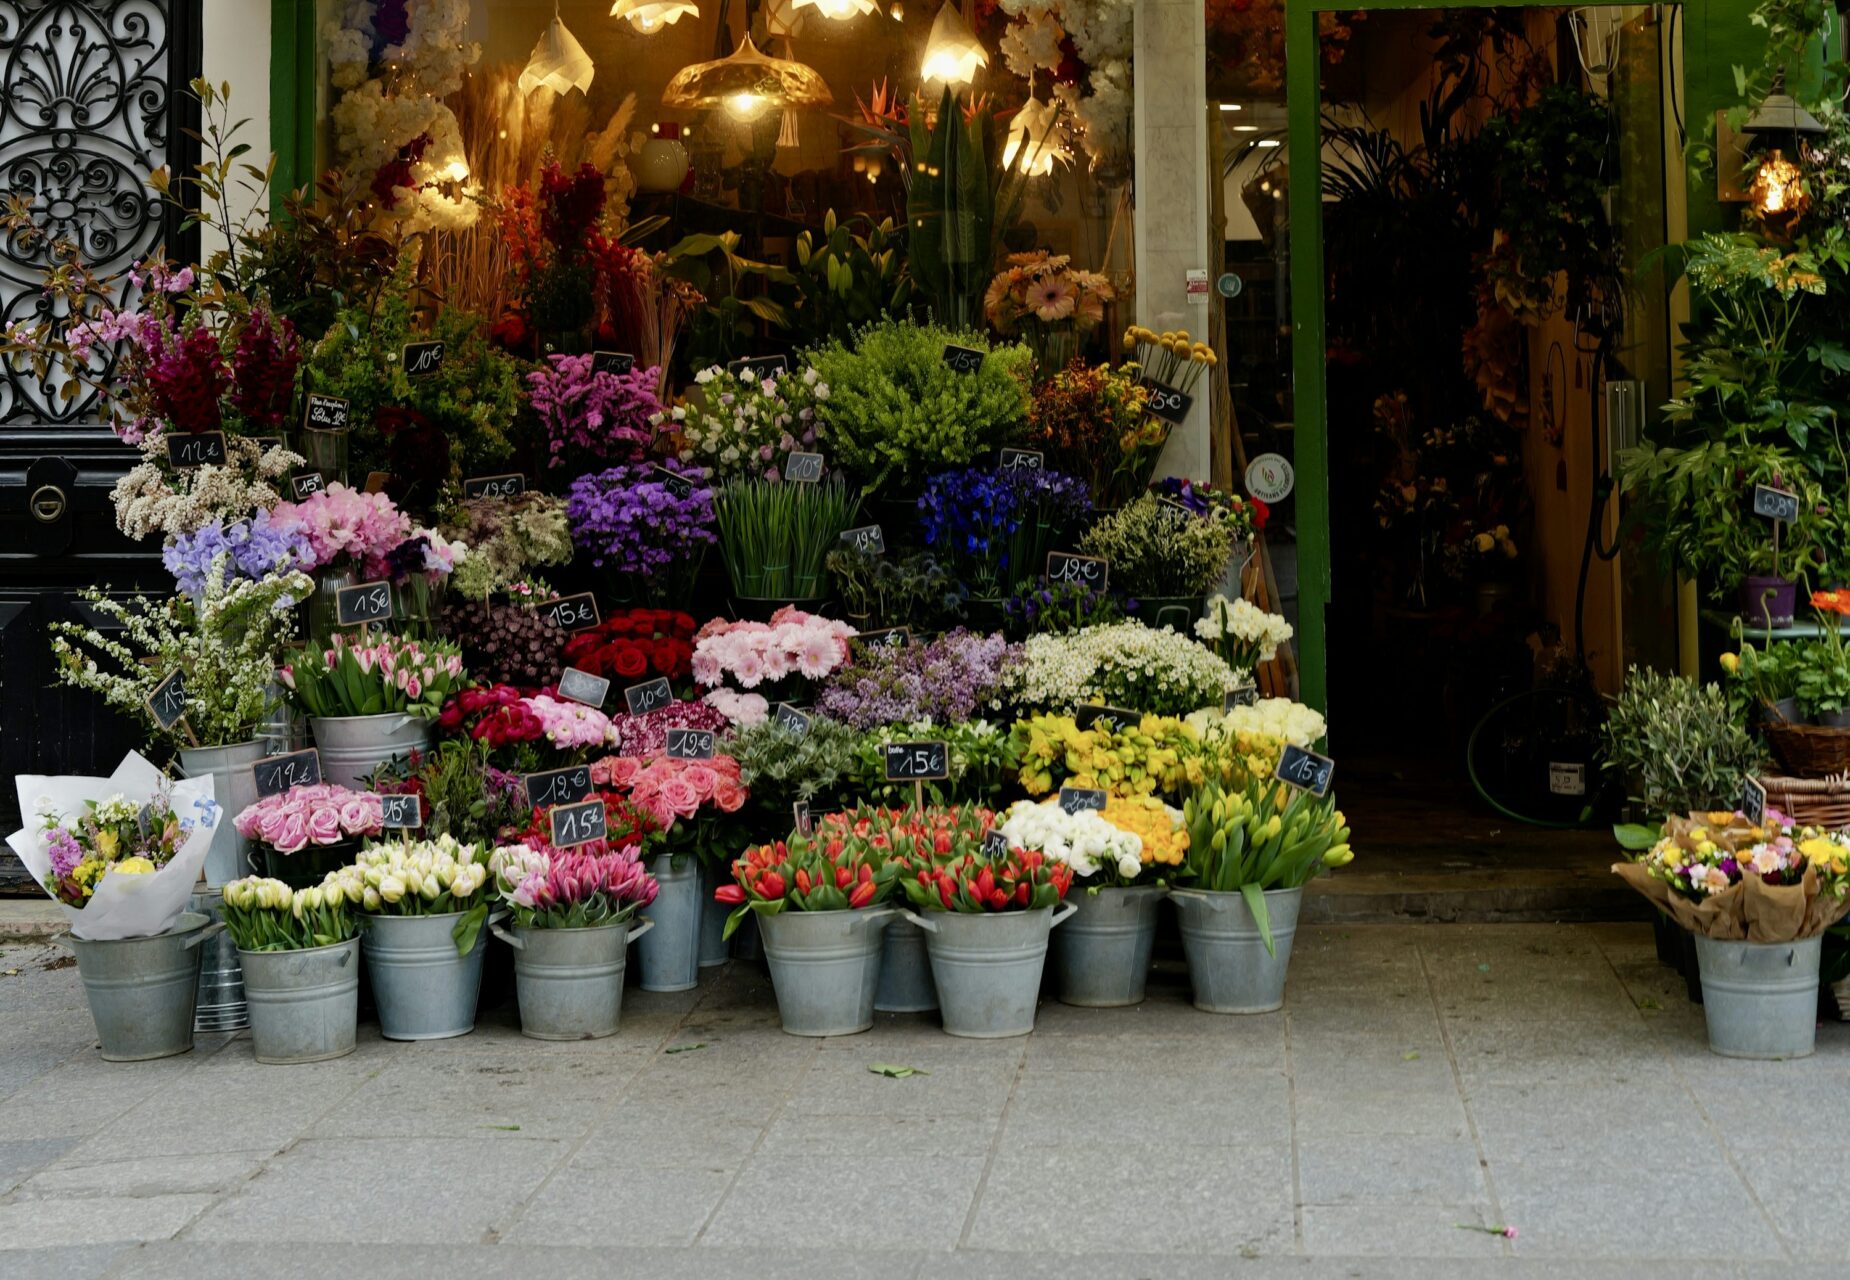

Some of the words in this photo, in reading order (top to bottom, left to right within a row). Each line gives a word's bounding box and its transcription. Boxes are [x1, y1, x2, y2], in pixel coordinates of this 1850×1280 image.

[410, 345, 441, 371] 10€
[181, 440, 219, 462] 12€
[792, 456, 820, 478] 10€
[299, 475, 320, 493] 15€
[354, 588, 388, 614] 15€
[549, 602, 594, 627] 15€
[164, 677, 186, 713] 15
[636, 683, 667, 709] 10€
[671, 732, 710, 757] 12€
[268, 762, 312, 788] 12€
[899, 750, 941, 775] 15€
[1289, 755, 1327, 784] 15€
[537, 770, 586, 802] 12€
[385, 796, 408, 822] 15€
[561, 807, 603, 839] 15€
